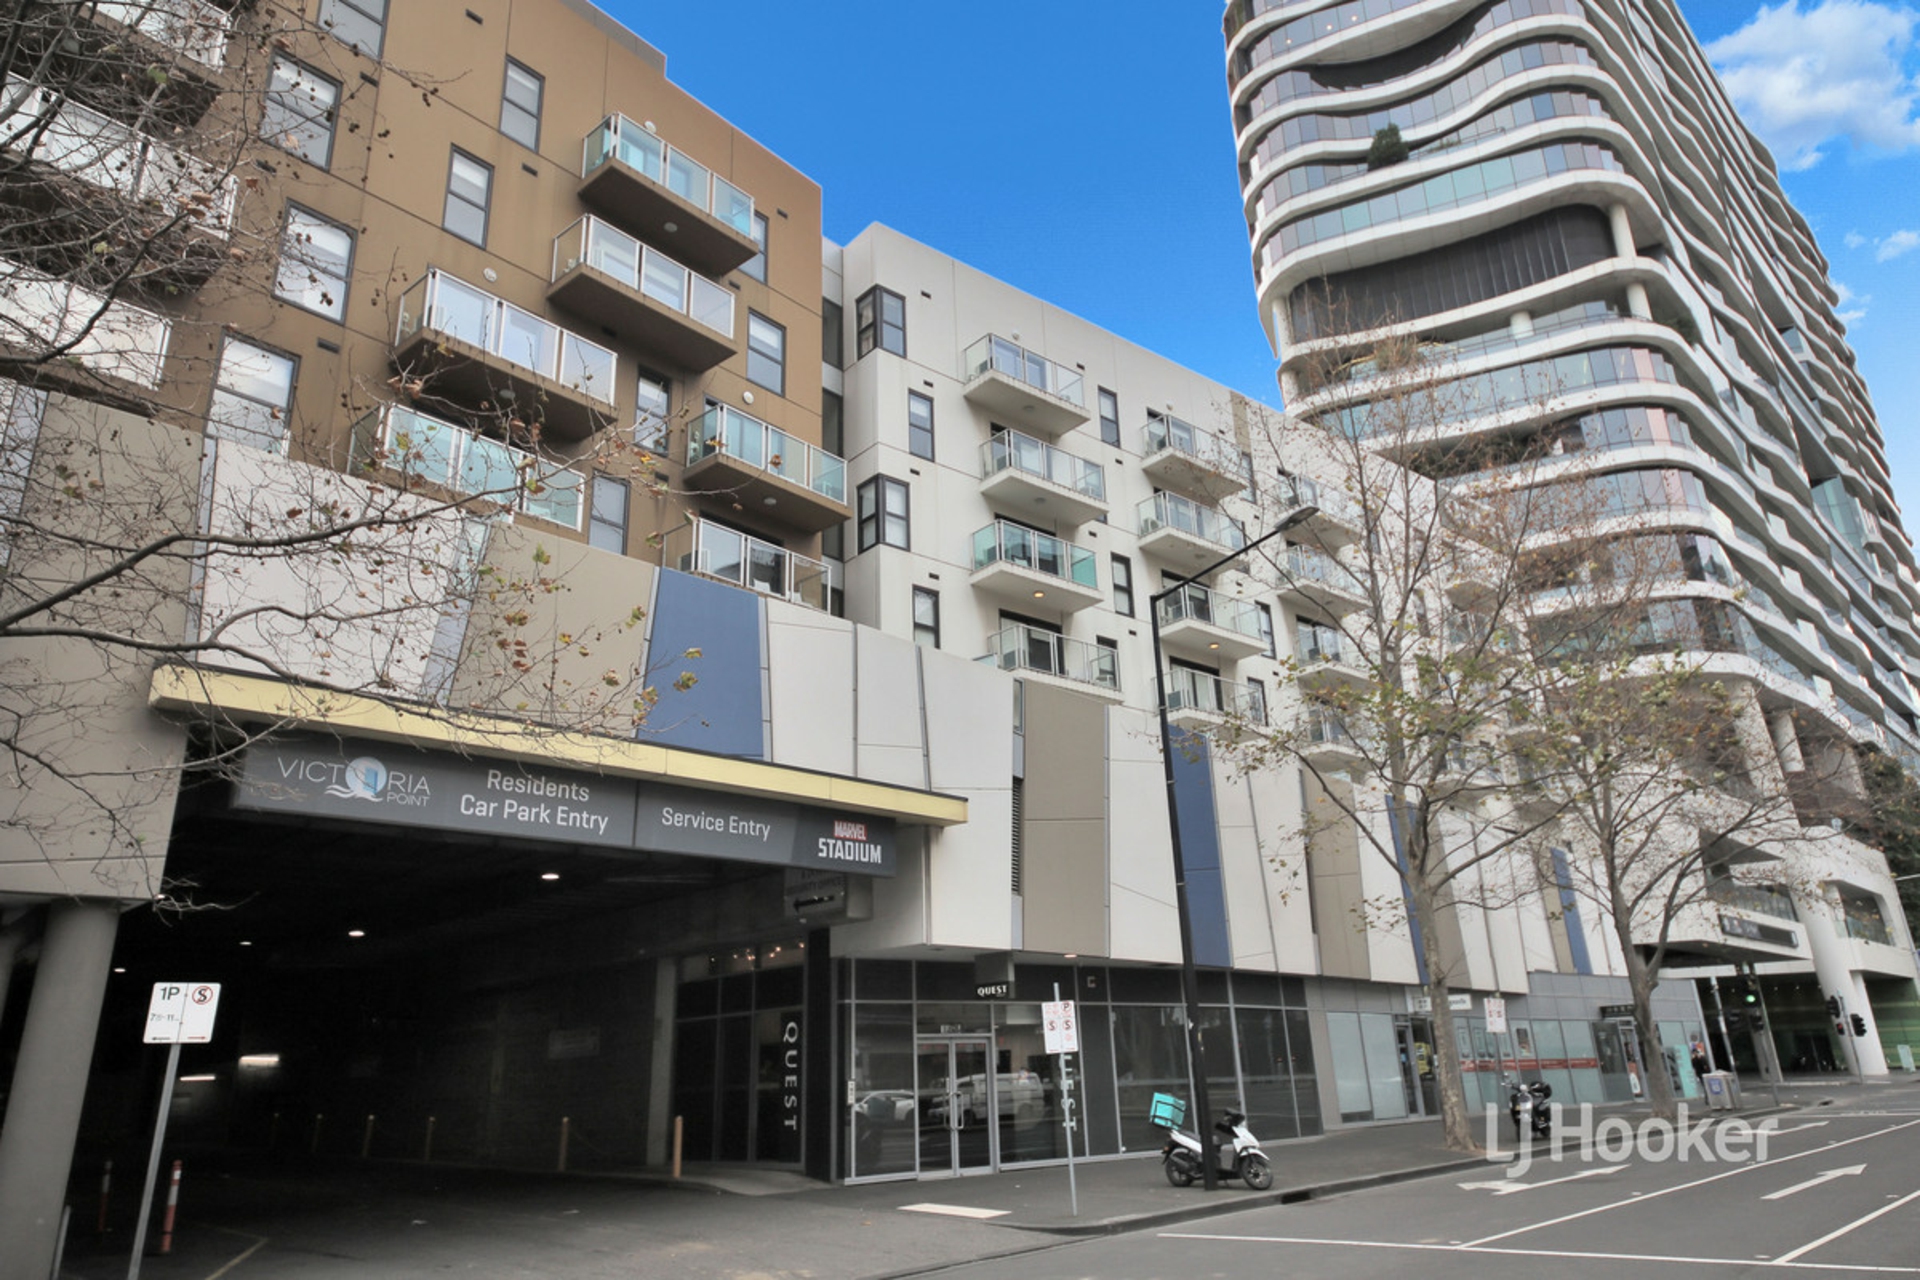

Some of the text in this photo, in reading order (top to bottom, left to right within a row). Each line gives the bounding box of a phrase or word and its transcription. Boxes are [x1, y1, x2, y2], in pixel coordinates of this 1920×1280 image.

[277, 756, 431, 798] VICTORIA
[487, 769, 590, 801] Residents
[386, 791, 430, 807] POINT
[460, 794, 609, 835] Car Park Entry
[661, 807, 771, 842] Service Entry
[834, 820, 867, 840] MARVEL
[818, 838, 882, 864] STADIUM
[160, 986, 180, 1001] 1P
[977, 985, 1007, 997] QUEST
[783, 1021, 799, 1131] QUEST
